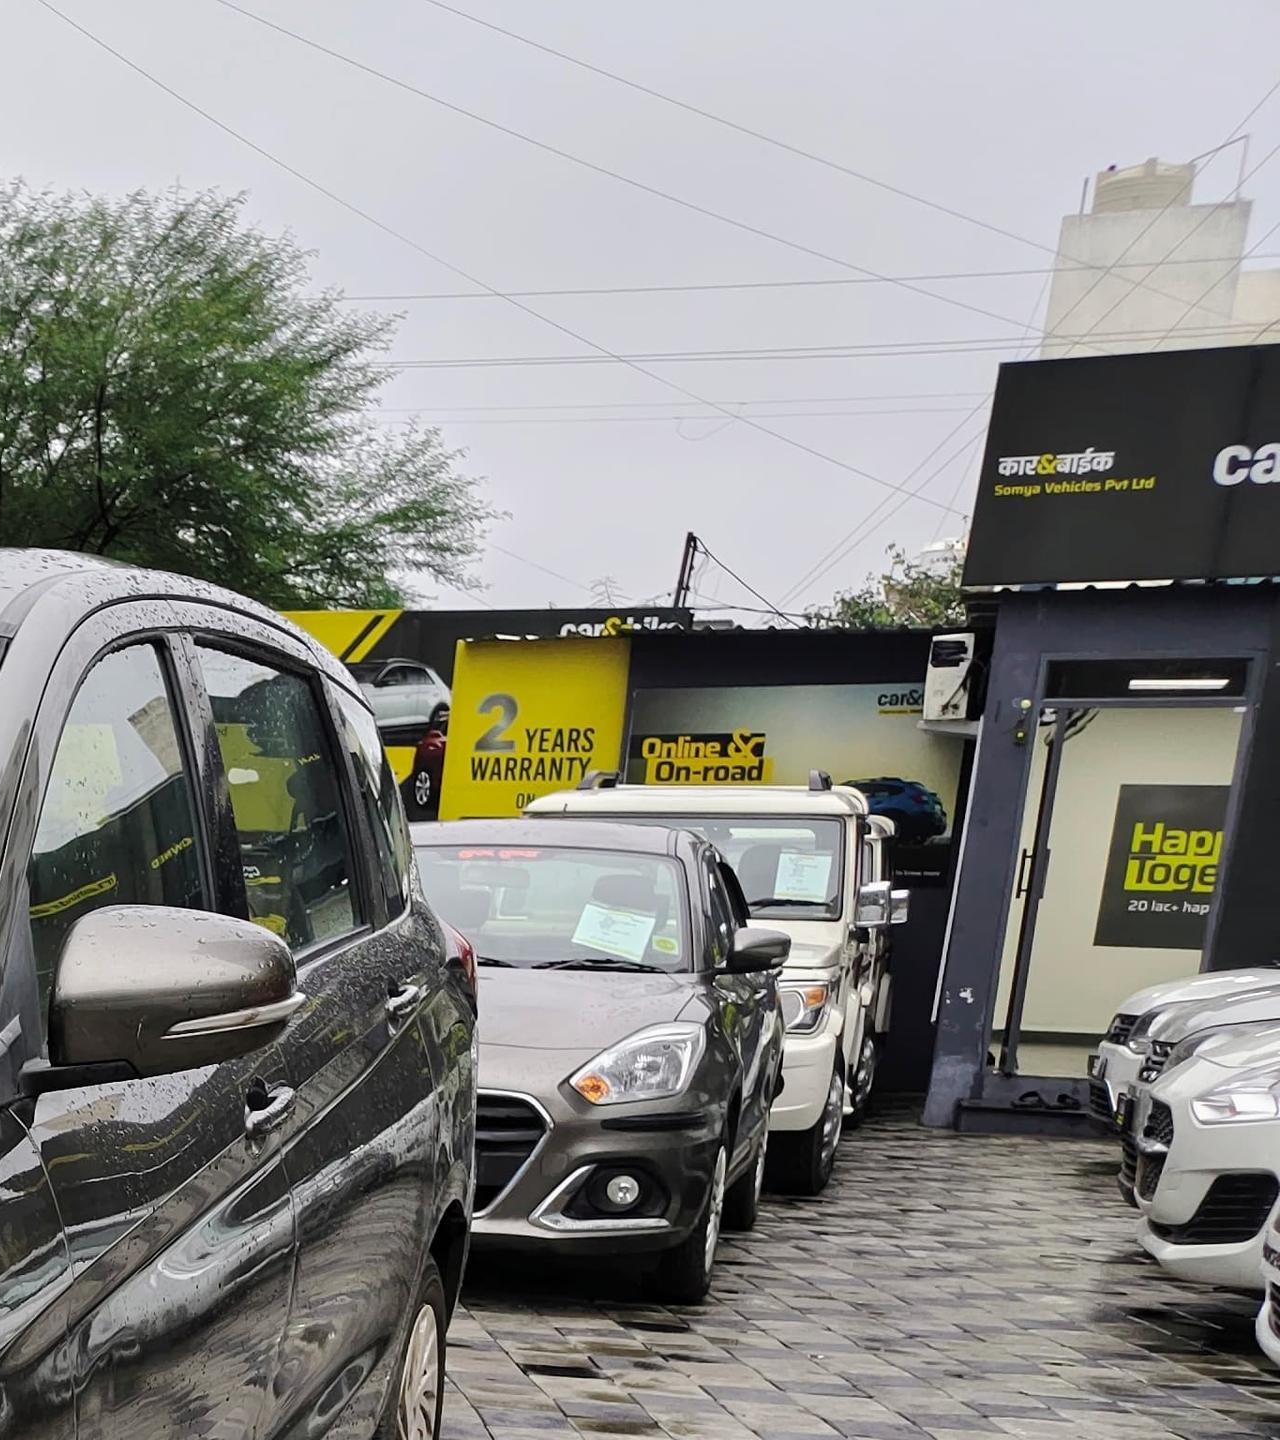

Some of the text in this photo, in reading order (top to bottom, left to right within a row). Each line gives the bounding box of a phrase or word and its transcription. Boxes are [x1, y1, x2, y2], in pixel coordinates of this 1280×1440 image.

[1213, 442, 1280, 486] ca
[994, 476, 1156, 497] Somya Vehicles Pvt Ltd
[877, 689, 923, 706] car&
[474, 691, 596, 753] 2 YEARS
[641, 728, 765, 760] Online &
[470, 757, 592, 782] WARRANTY
[655, 759, 764, 783] On-road
[1128, 900, 1148, 912] 20
[1182, 901, 1210, 915] hap
